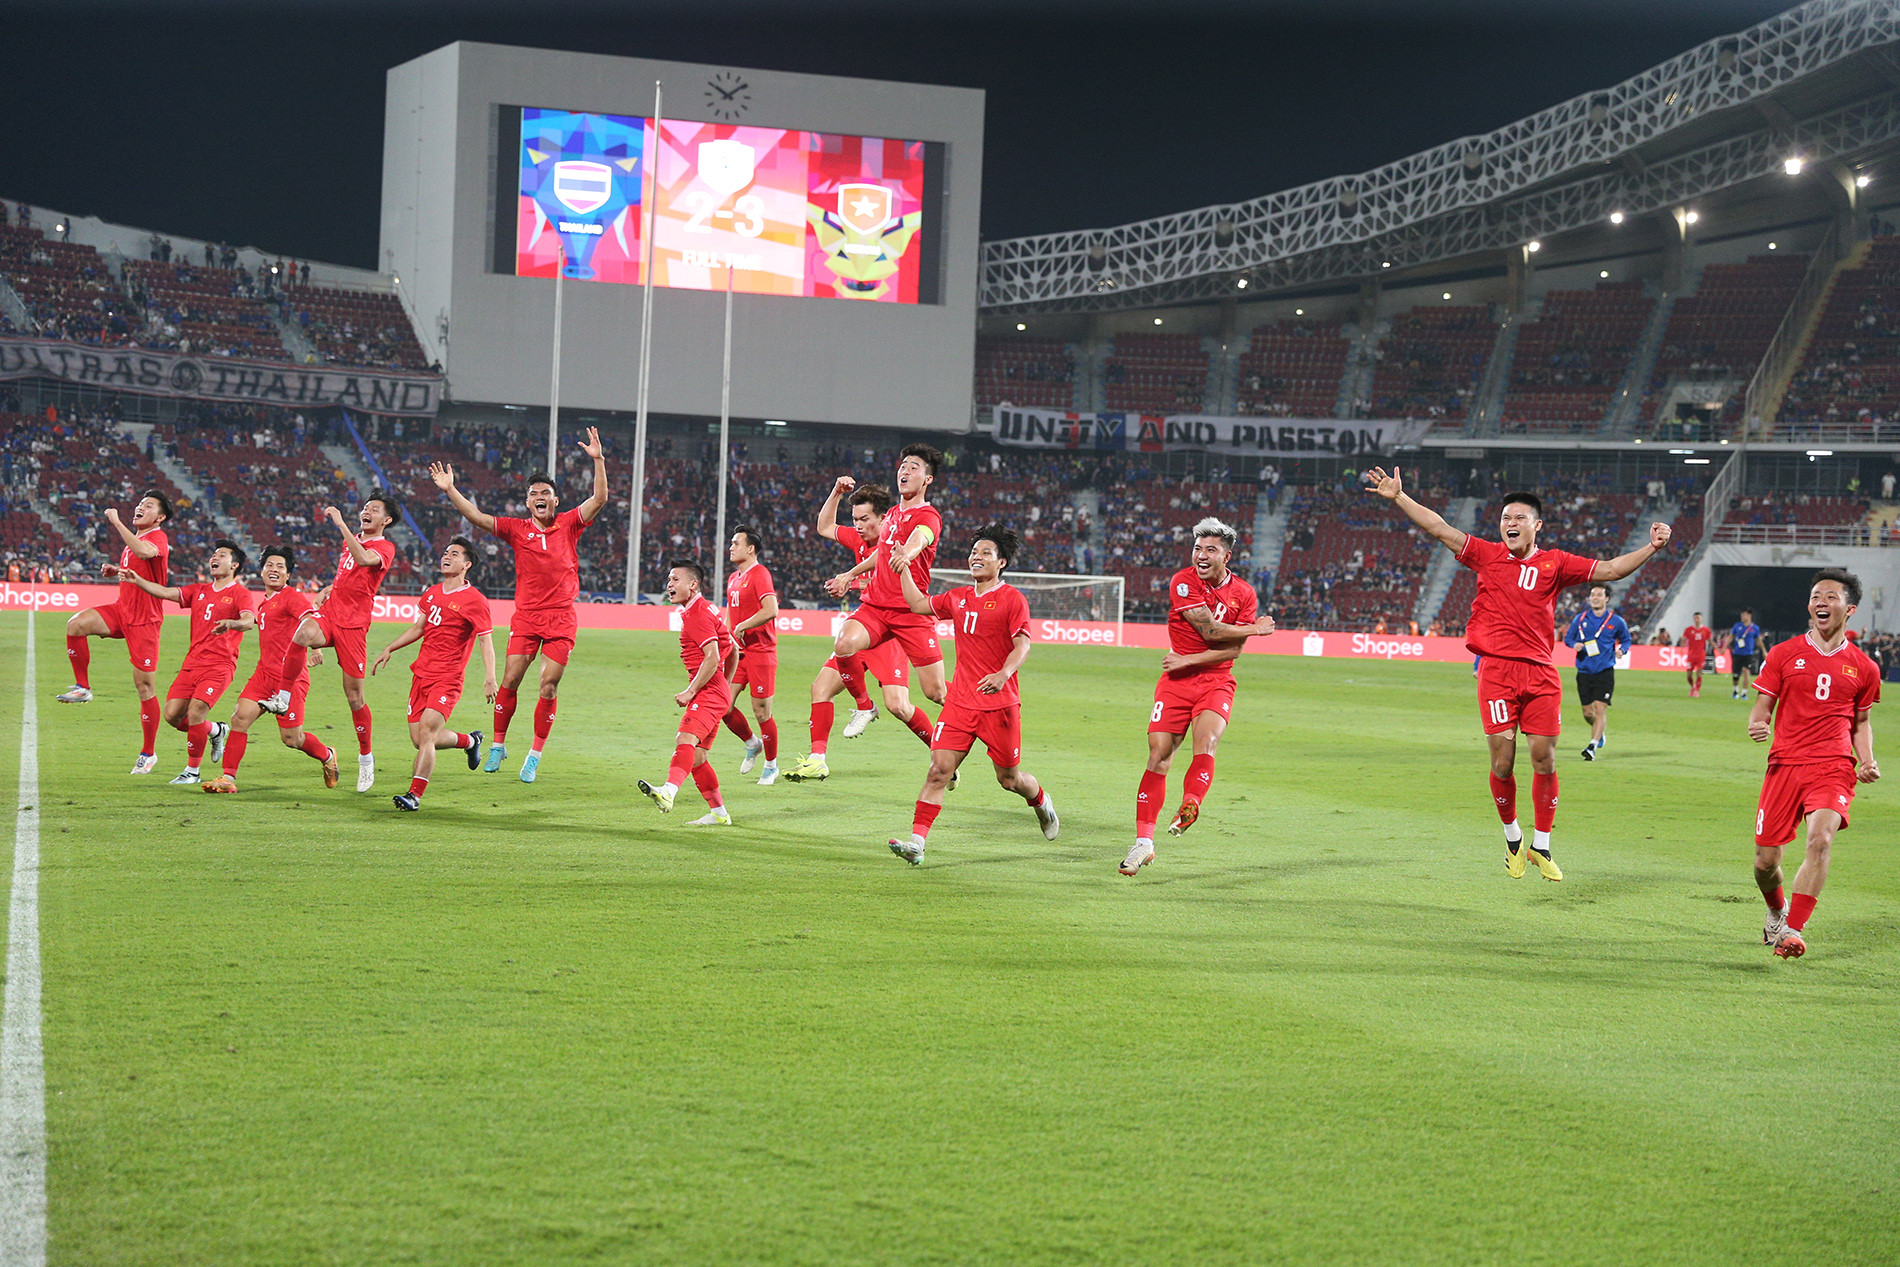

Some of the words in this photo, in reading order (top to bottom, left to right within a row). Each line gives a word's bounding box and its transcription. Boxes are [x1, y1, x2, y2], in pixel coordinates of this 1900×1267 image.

[683, 190, 766, 238] 2-3
[682, 249, 721, 268] FULL
[209, 365, 430, 411] THAILAND
[1000, 411, 1121, 442] UNITY
[1135, 421, 1216, 445] AND
[1232, 424, 1383, 454] PASSION
[536, 533, 547, 550] 7
[886, 524, 897, 545] 2
[1518, 564, 1539, 591] 10
[0, 583, 79, 611] hopee
[730, 590, 740, 607] 20
[203, 603, 215, 620] 5
[427, 604, 442, 626] 26
[963, 611, 978, 635] 17
[1041, 620, 1115, 645] Shopee
[1351, 633, 1424, 659] Shopee
[1815, 673, 1832, 700] 8
[1488, 698, 1509, 725] 10
[1755, 808, 1765, 836] 8
